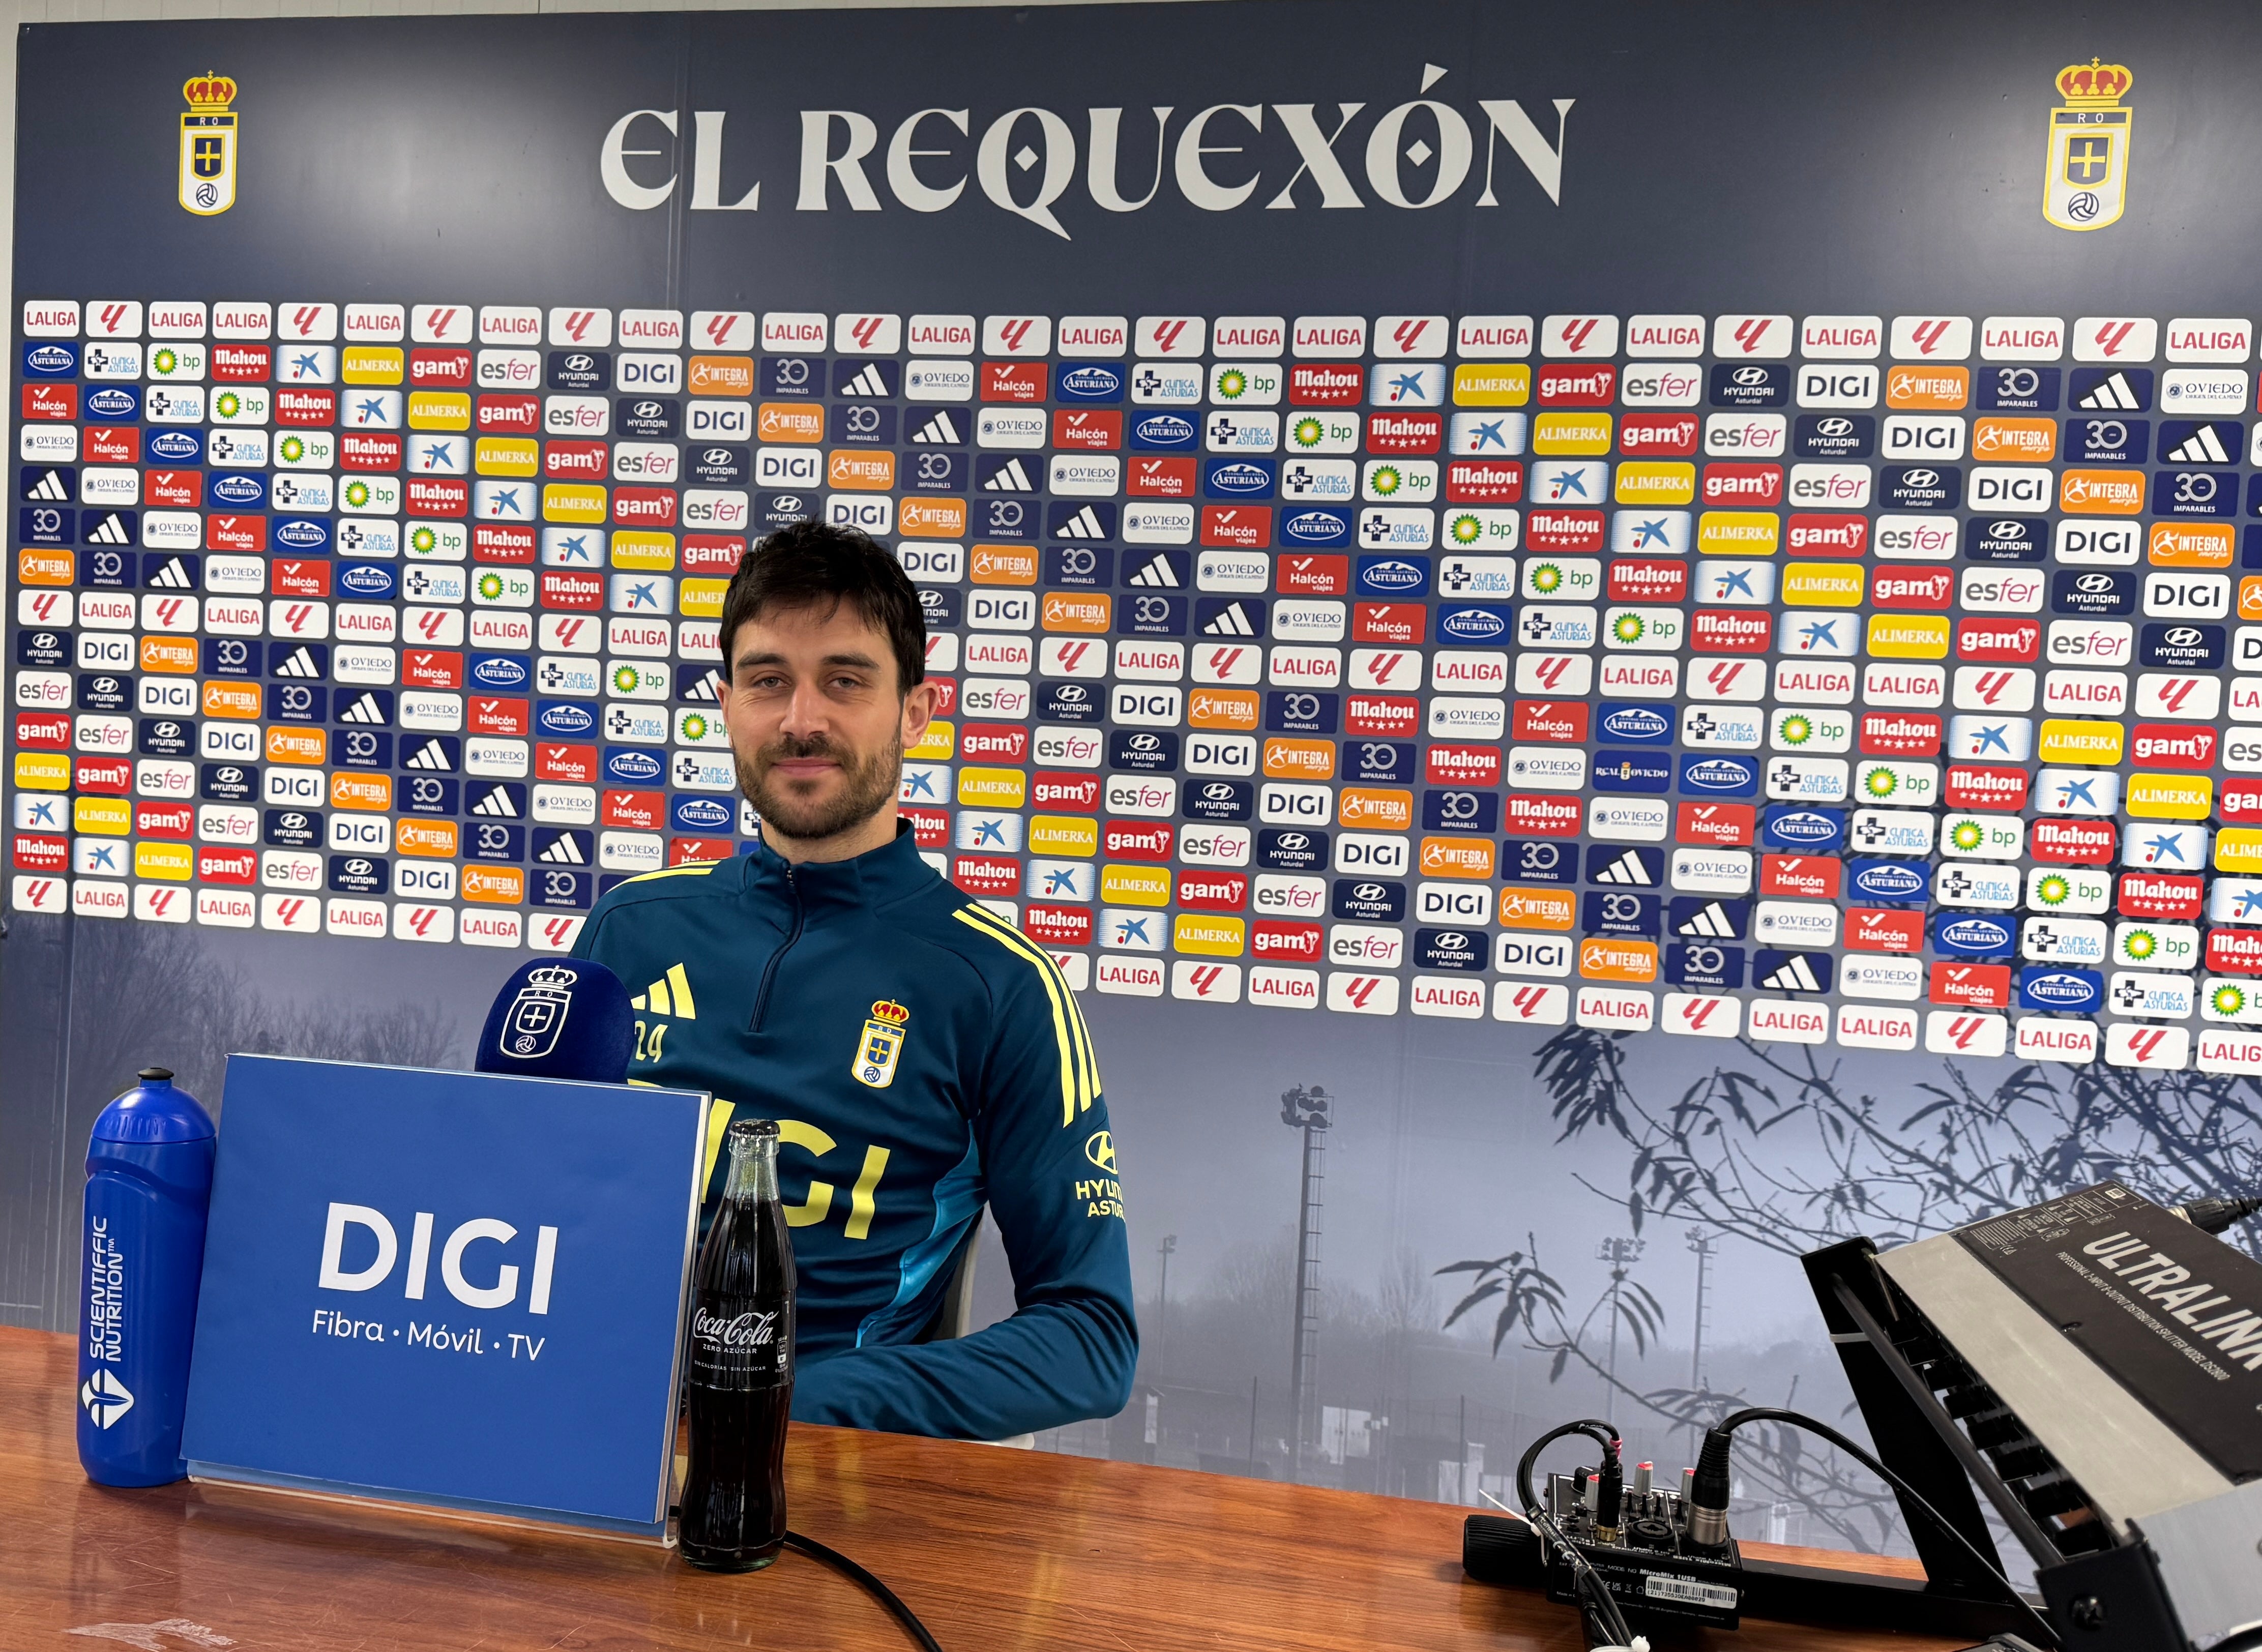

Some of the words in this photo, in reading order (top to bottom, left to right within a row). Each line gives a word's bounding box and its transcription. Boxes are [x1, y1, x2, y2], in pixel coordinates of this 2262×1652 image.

[600, 109, 760, 211] EL
[796, 63, 1576, 241] REQUEXÓN
[27, 312, 76, 326] LALIGA
[347, 315, 400, 330] LALIGA
[483, 318, 538, 333] LALIGA
[912, 327, 971, 343] LALIGA
[1217, 330, 1280, 345] LALIGA
[1461, 329, 1527, 345] LALIGA
[1986, 330, 2058, 347] LALIGA
[184, 354, 200, 370] bp
[216, 350, 267, 365] Mahou
[346, 360, 400, 371] ALIMERKA
[481, 359, 537, 380] esfer
[625, 364, 673, 383] DIGI
[710, 367, 748, 381] INTEGRA
[925, 373, 970, 382] OVIEDO
[993, 381, 1034, 391] Halcón
[1068, 376, 1115, 388] ASTURIANA
[1254, 375, 1275, 394] bp
[1458, 379, 1525, 391] ALIMERKA
[1627, 373, 1697, 397] esfer
[1915, 378, 1961, 394] INTEGRA
[2186, 383, 2243, 393] OVIEDO
[1724, 388, 1774, 396] HYUNDAI
[33, 401, 67, 411] Halcón
[247, 398, 263, 414] bp
[1372, 419, 1436, 435] Mahou
[37, 436, 74, 446] OVIEDO
[1892, 427, 1955, 448] DIGI
[479, 451, 534, 463] ALIMERKA
[1070, 468, 1115, 478] OVIEDO
[1409, 473, 1430, 491] bp
[1620, 477, 1689, 489] ALIMERKA
[687, 499, 744, 521] esfer
[922, 509, 960, 524] INTEGRA
[159, 523, 198, 533] OVIEDO
[1490, 521, 1511, 538] bp
[1703, 527, 1774, 540] ALIMERKA
[218, 532, 253, 542] Halcón
[477, 530, 532, 547] Mahou
[1880, 525, 1953, 549] esfer
[2179, 536, 2226, 551] INTEGRA
[38, 560, 70, 574] INTEGRA
[1614, 566, 1682, 582] Mahou
[345, 576, 390, 587] ASTURIANA
[1368, 571, 1421, 583] ASTURIANA
[510, 579, 528, 597] bp
[1966, 578, 2039, 602] esfer
[2154, 585, 2220, 607] DIGI
[208, 608, 259, 624] LALIGA
[976, 600, 1027, 620] DIGI
[612, 628, 667, 645] LALIGA
[27, 650, 62, 658] HYUNDAI
[85, 642, 127, 660] DIGI
[970, 646, 1027, 662] LALIGA
[1437, 663, 1502, 680] LALIGA
[646, 674, 664, 689] bp
[1868, 676, 1939, 694] LALIGA
[19, 680, 68, 700] esfer
[2049, 683, 2121, 702] LALIGA
[966, 690, 1026, 710] esfer
[1120, 695, 1173, 716] DIGI
[1213, 701, 1253, 715] INTEGRA
[480, 714, 516, 724] Halcón
[209, 732, 253, 751] DIGI
[284, 738, 321, 752] INTEGRA
[962, 781, 1020, 794] ALIMERKA
[1906, 775, 1929, 793] bp
[550, 797, 592, 808] OVIEDO
[2132, 789, 2206, 804] ALIMERKA
[1692, 821, 1739, 834] Halcón
[17, 839, 65, 855] Mahou
[1184, 835, 1246, 857] esfer
[1344, 844, 1400, 865] DIGI
[1444, 846, 1488, 865] INTEGRA
[1105, 879, 1166, 893] ALIMERKA
[2078, 882, 2102, 901] bp
[2125, 879, 2197, 900] Mahou
[1346, 900, 1391, 911] HYUNDAI
[331, 910, 383, 926] LALIGA
[1100, 966, 1160, 985] LALIGA
[1581, 1001, 1648, 1019] LALIGA
[1754, 1012, 1823, 1031] LALIGA
[635, 1020, 667, 1063] 24
[2020, 1030, 2091, 1050] LALIGA
[318, 1202, 558, 1315] DIGI
[90, 1216, 107, 1360] SCIENTIFFIC
[693, 1307, 779, 1345] Coca-Cola
[312, 1310, 385, 1342] Fibra
[407, 1321, 483, 1354] Móvil
[508, 1333, 545, 1361] TV
[703, 1343, 721, 1352] ZERO
[1639, 1569, 1675, 1579] MicroMix
